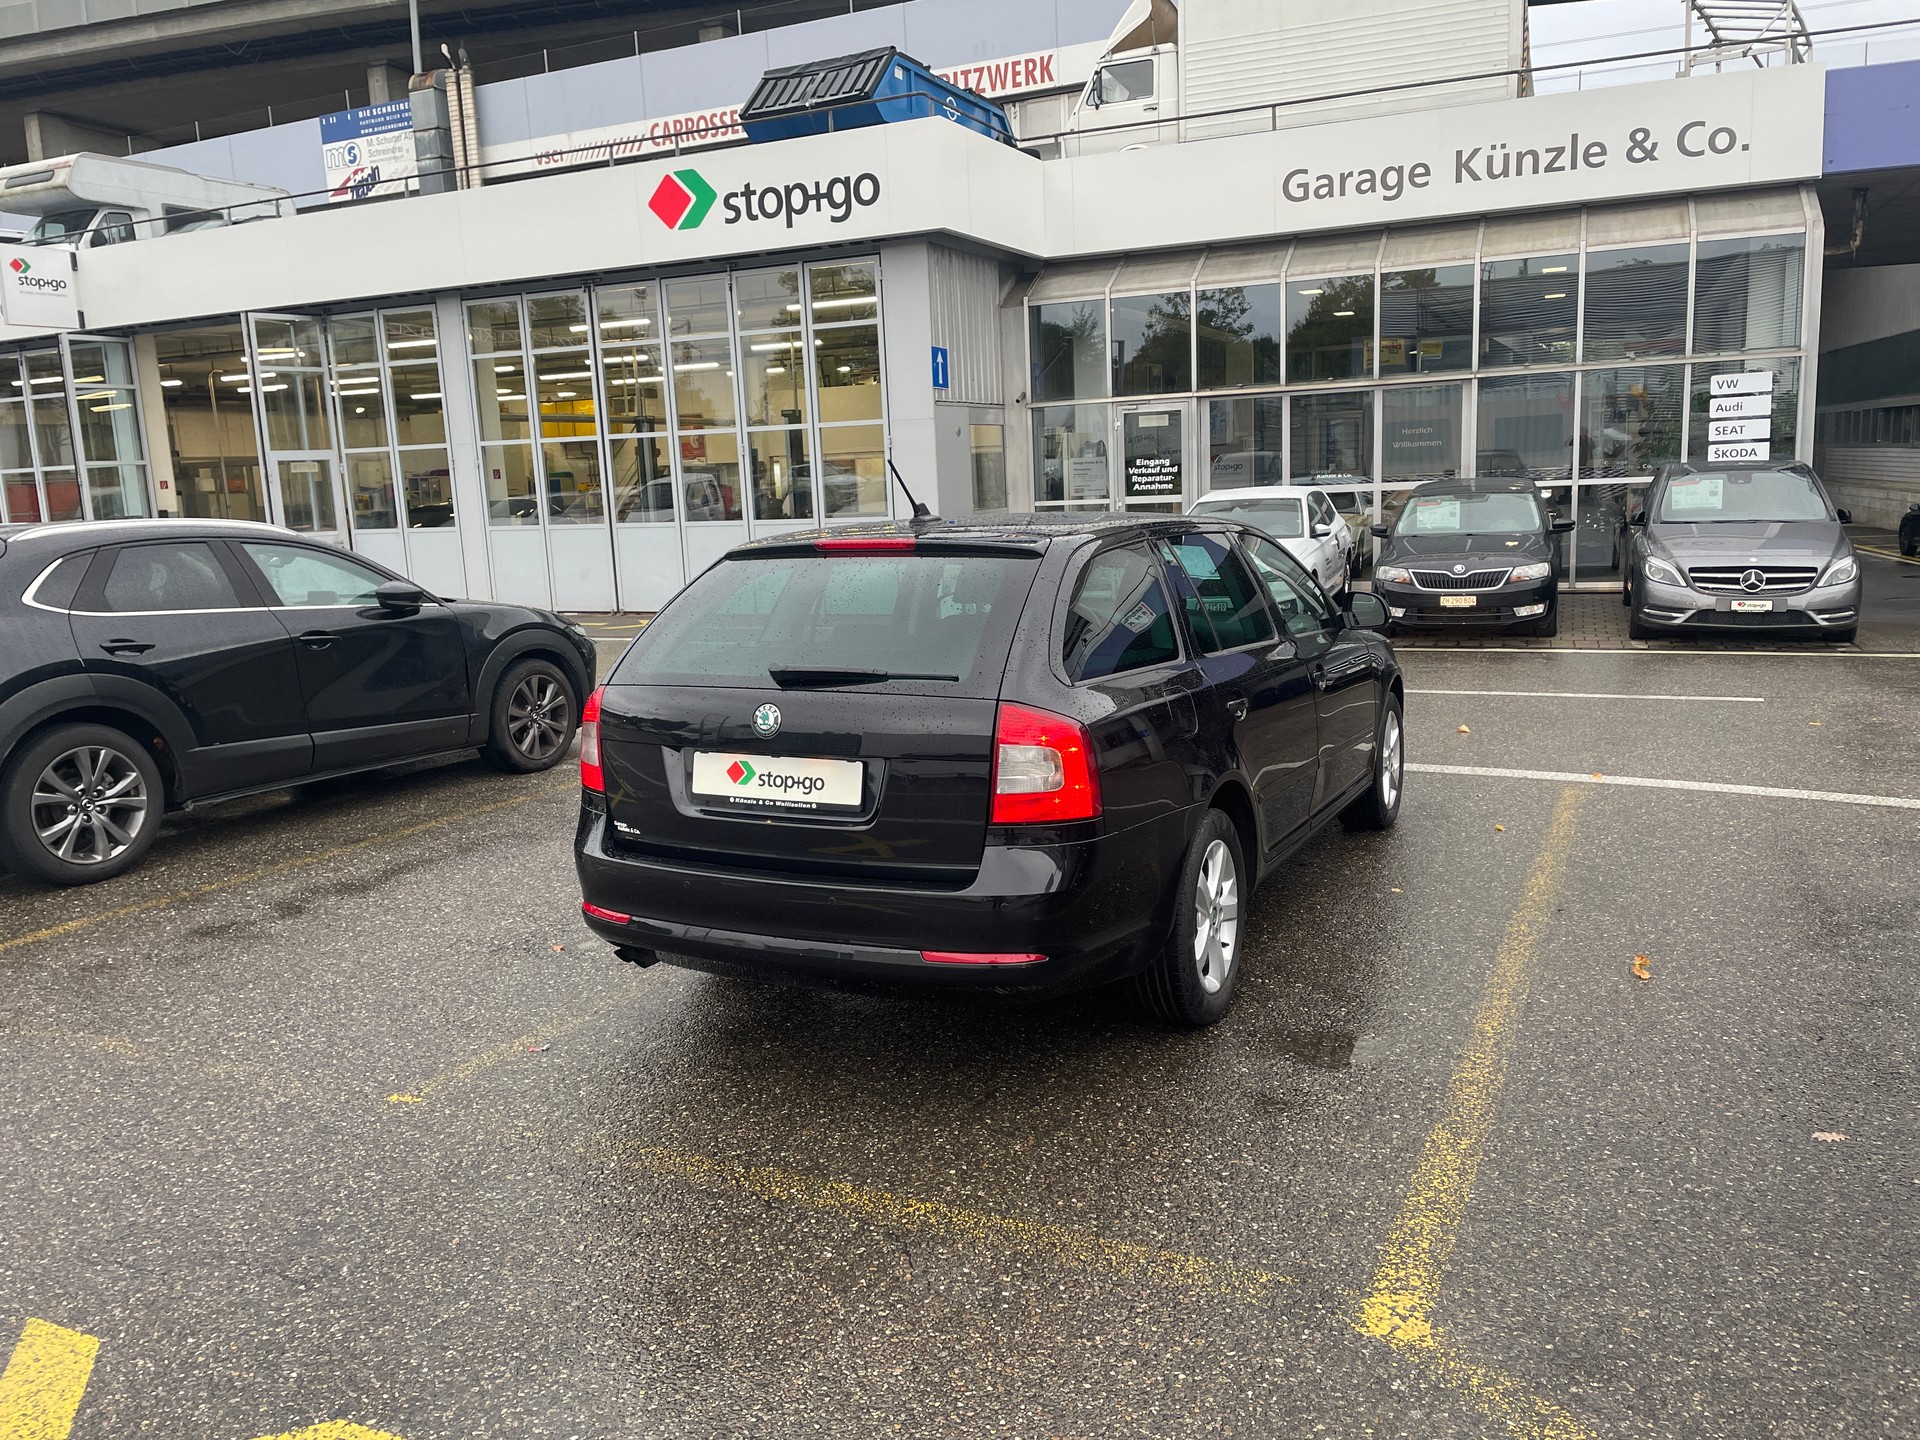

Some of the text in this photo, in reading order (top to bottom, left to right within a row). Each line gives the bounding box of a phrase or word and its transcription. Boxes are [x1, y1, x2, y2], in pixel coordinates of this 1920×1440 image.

[358, 102, 409, 118] DIE SCHREINE
[650, 109, 745, 147] CARROSSE
[1282, 120, 1750, 202] Garage Künzle & Co.
[723, 172, 881, 229] stop+go
[18, 275, 67, 291] stop+go
[1716, 379, 1739, 390] VW
[1715, 401, 1744, 413] Audi
[1401, 427, 1433, 435] Herzlich
[1714, 425, 1746, 436] SEAT
[1392, 440, 1442, 449] Willkommen
[1713, 447, 1758, 459] ŠKODA
[1135, 458, 1170, 467] Eingang
[1128, 465, 1178, 474] Verkauf und
[1132, 474, 1175, 483] Reparatur-
[1133, 482, 1173, 491] Annahme
[758, 771, 825, 795] stop+go
